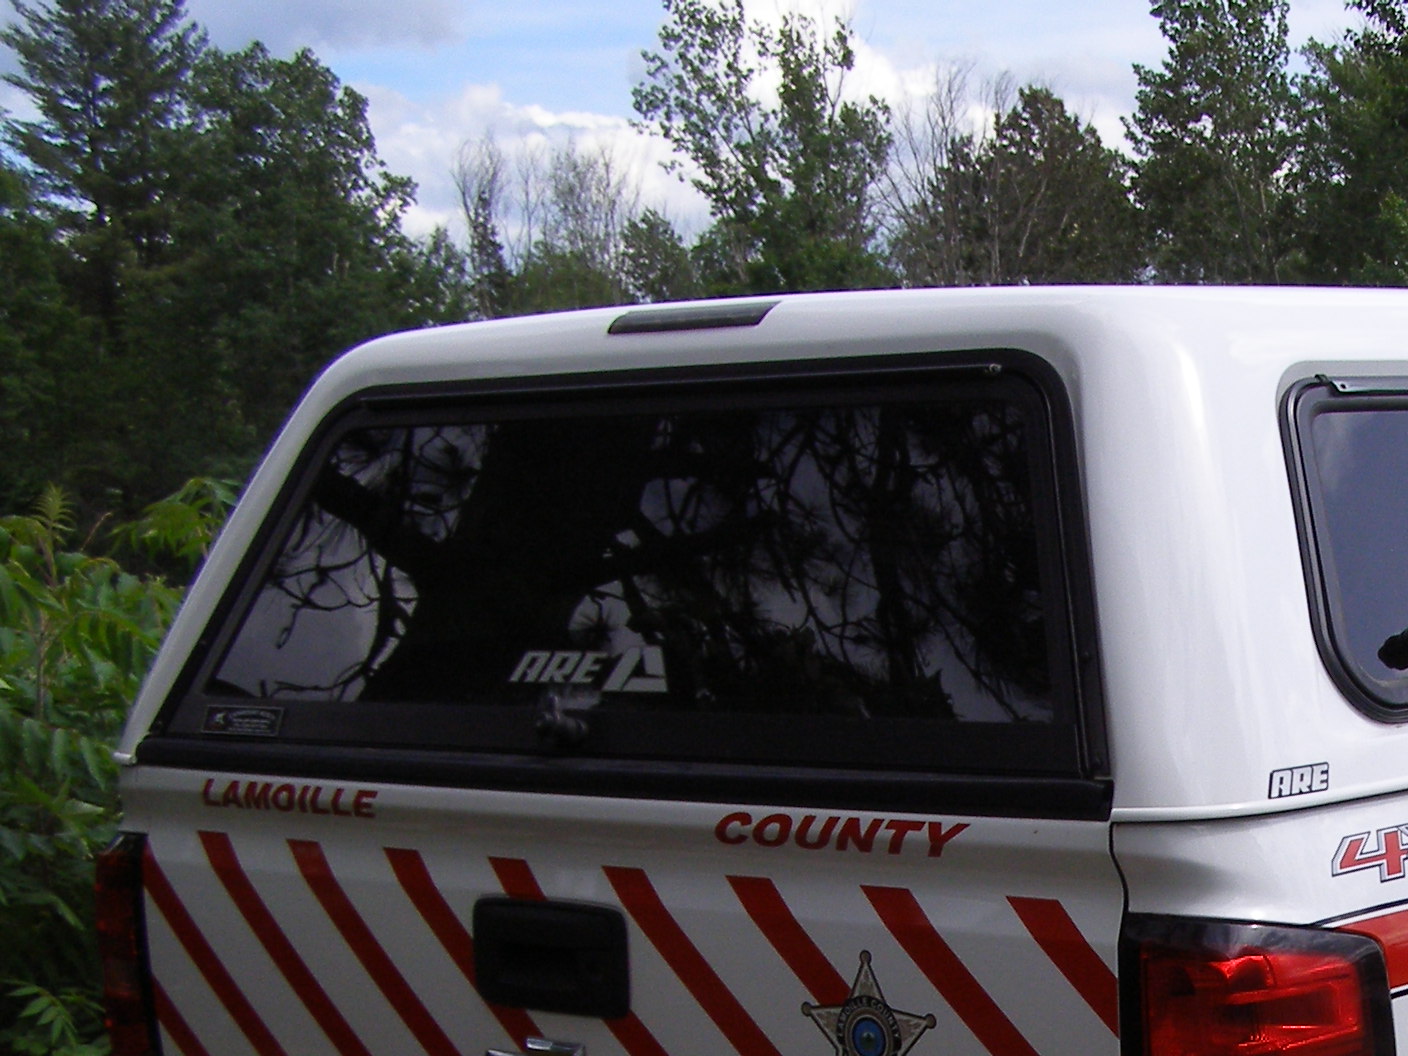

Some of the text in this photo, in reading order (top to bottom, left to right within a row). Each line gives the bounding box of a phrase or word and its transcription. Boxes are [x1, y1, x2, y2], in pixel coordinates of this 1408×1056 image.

[510, 651, 602, 683] ARE
[1269, 761, 1329, 799] ARE
[202, 779, 970, 857] LAMOILLE COUNTY
